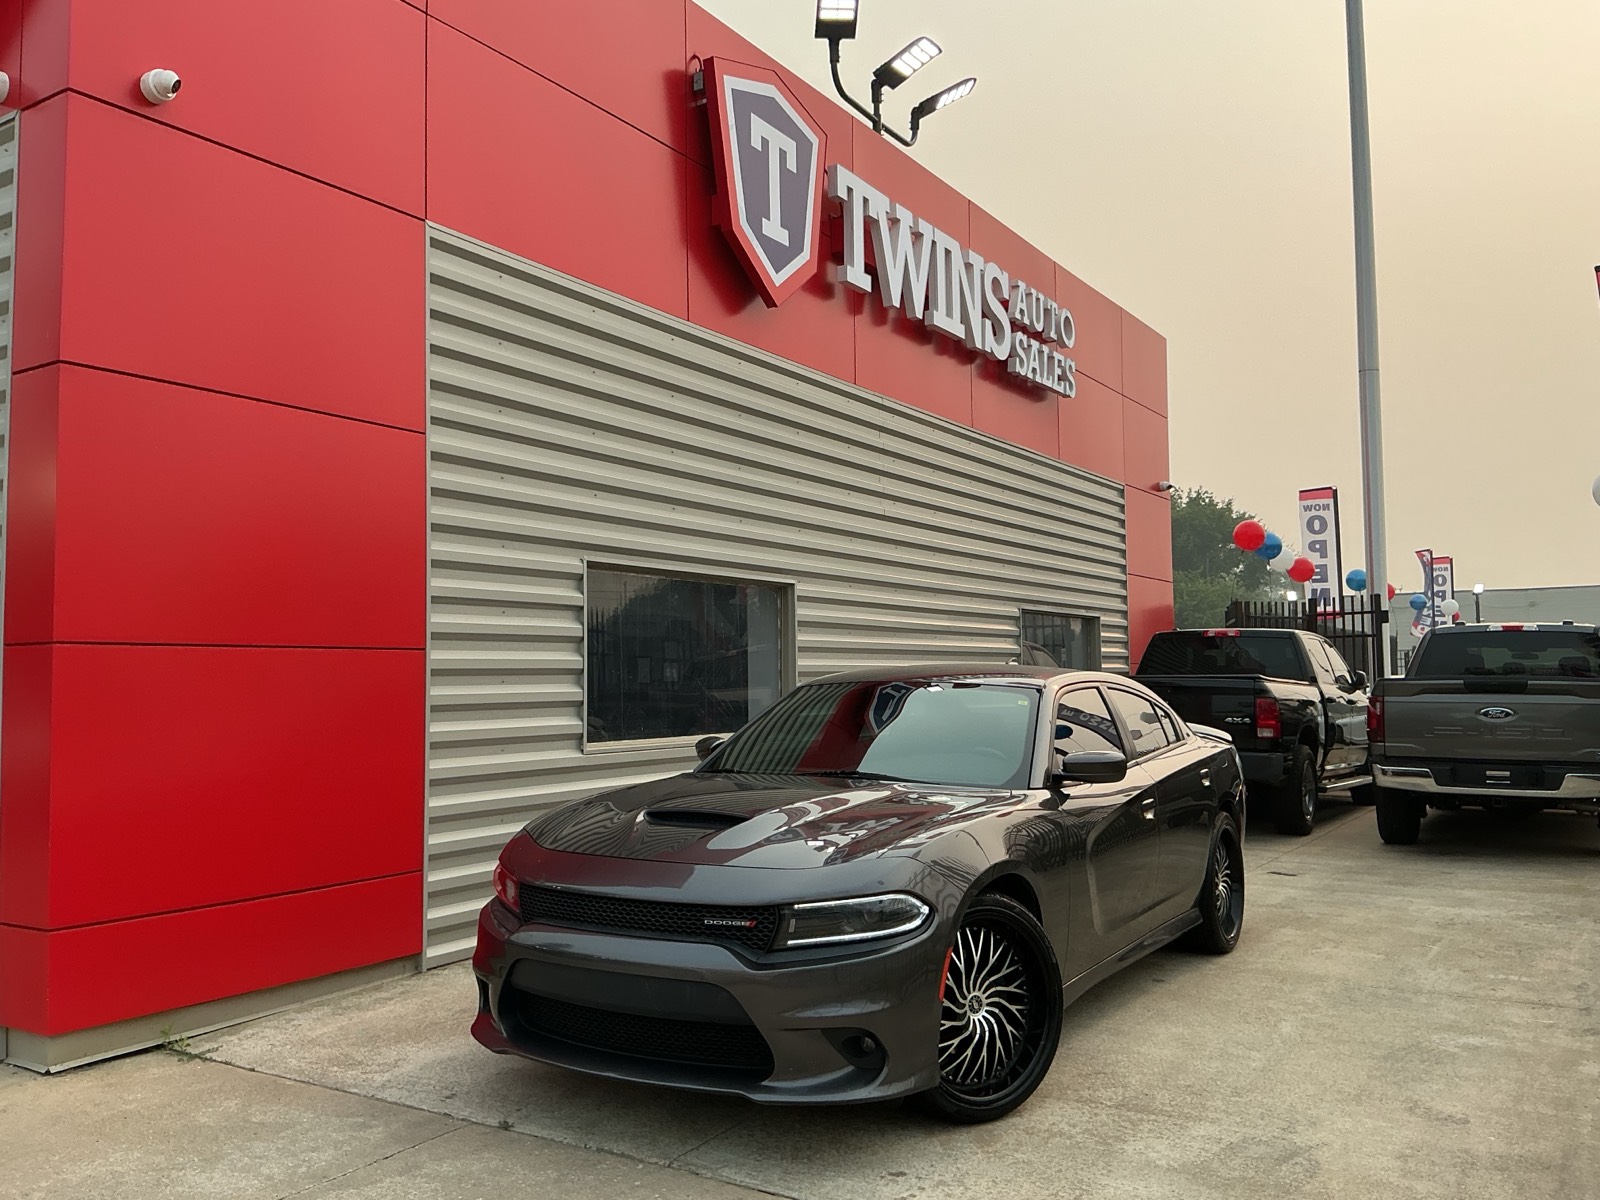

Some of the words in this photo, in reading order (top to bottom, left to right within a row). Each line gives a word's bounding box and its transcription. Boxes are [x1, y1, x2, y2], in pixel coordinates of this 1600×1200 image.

[750, 112, 797, 247] T
[827, 163, 1012, 361] TWINS
[1010, 280, 1076, 349] AUTO
[1009, 332, 1077, 399] SALES
[704, 919, 752, 927] DODGE
